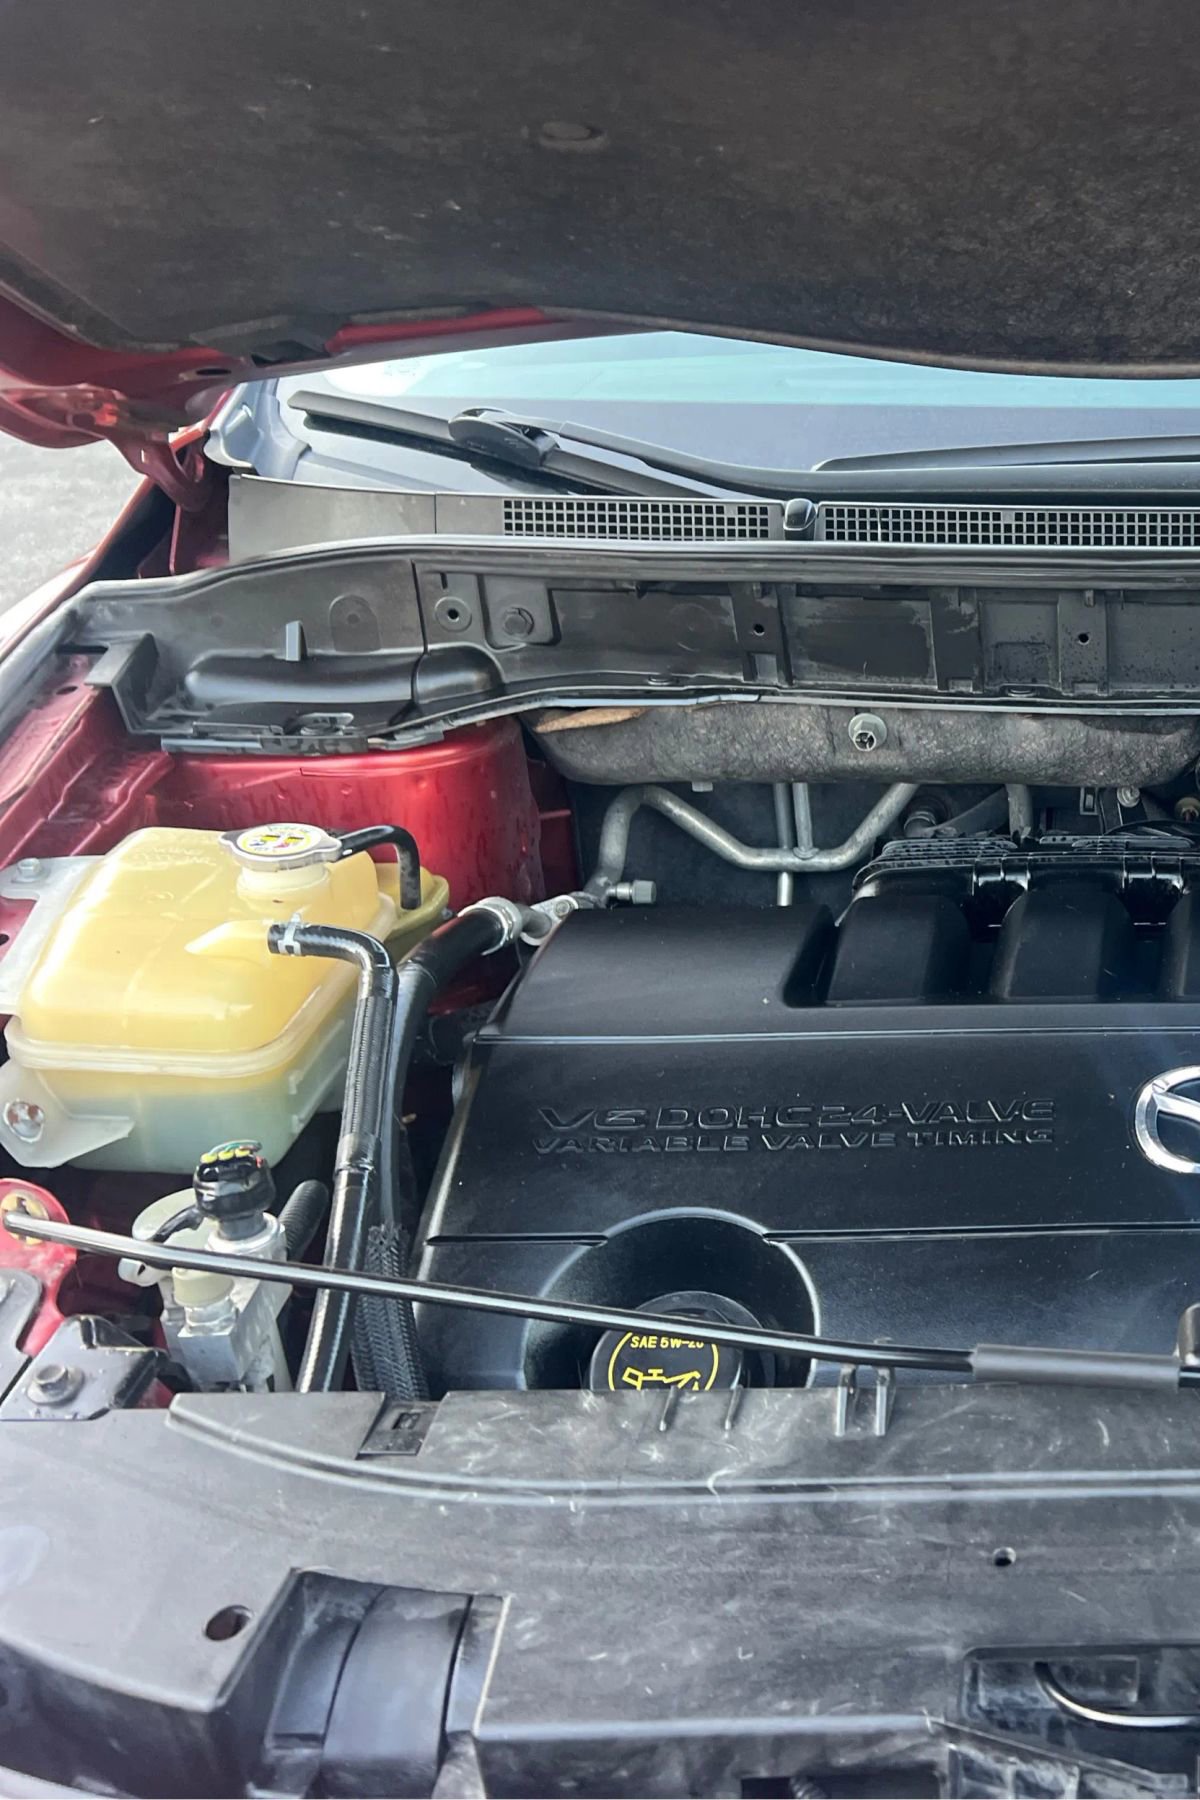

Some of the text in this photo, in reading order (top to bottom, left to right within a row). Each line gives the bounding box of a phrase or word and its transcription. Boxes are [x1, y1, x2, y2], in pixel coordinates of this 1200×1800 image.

[537, 1100, 1055, 1131] V6 DOHC 24-VALVE
[532, 1127, 1054, 1153] VARIABLE VALVE TIMING
[630, 1335, 658, 1349] SAE
